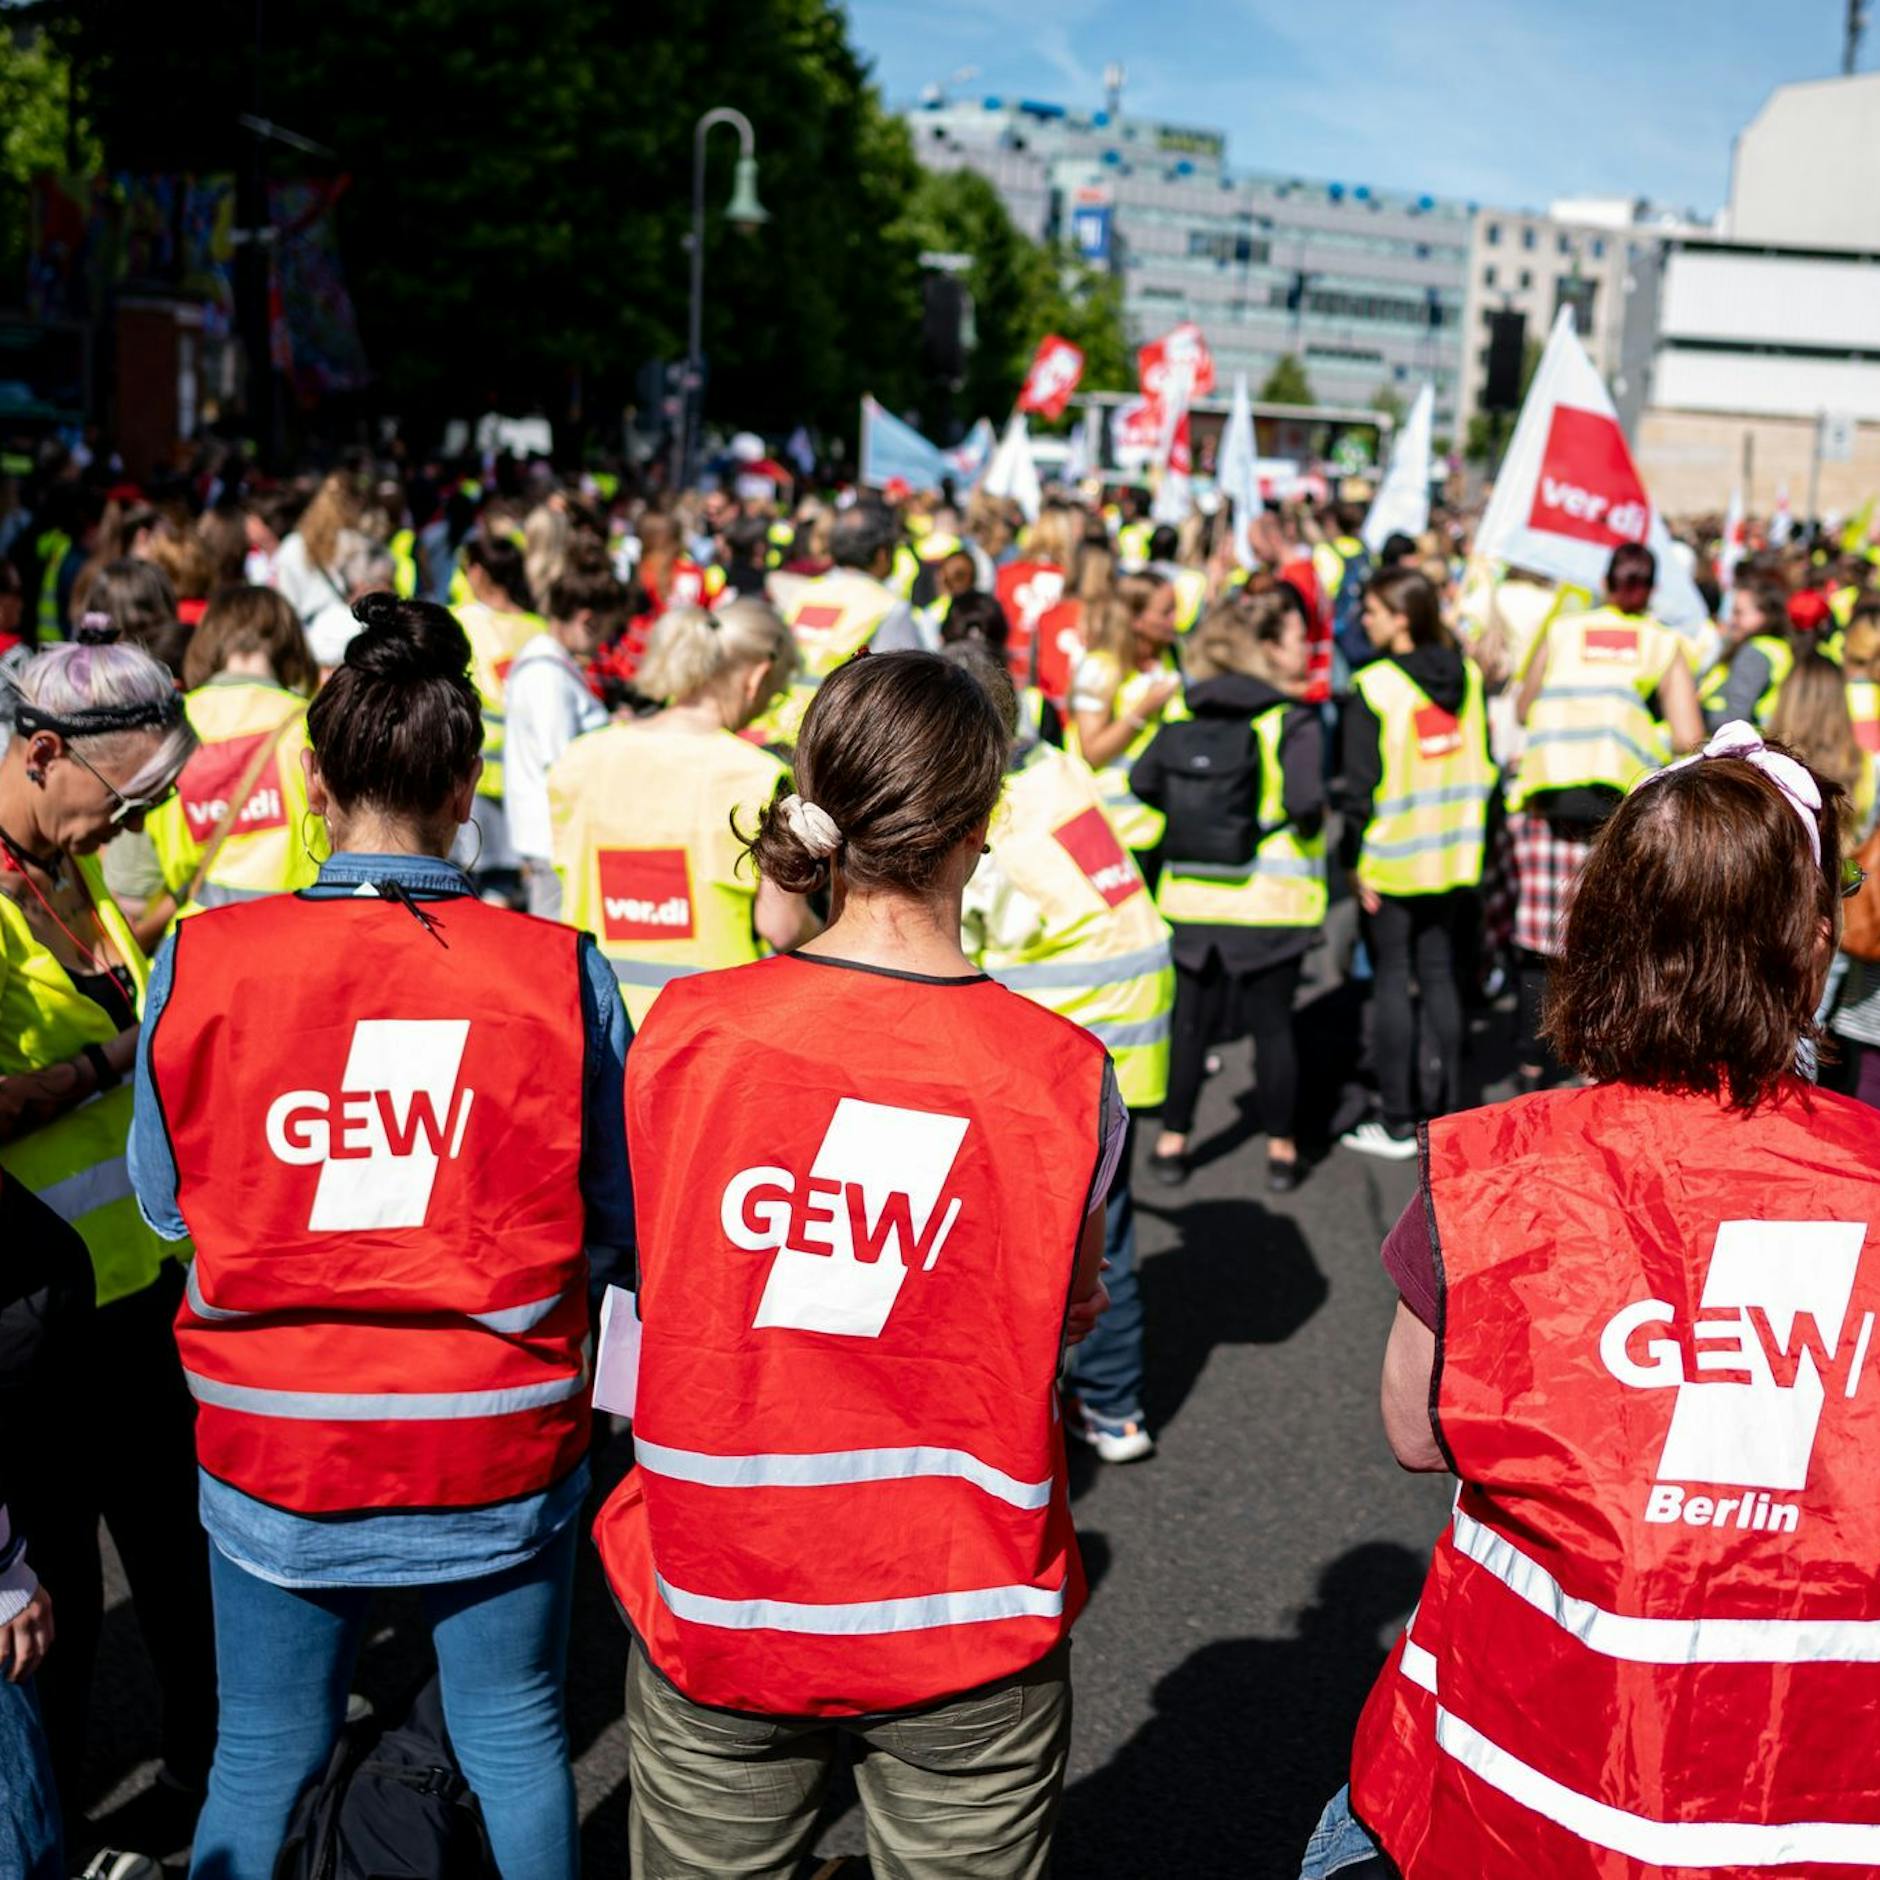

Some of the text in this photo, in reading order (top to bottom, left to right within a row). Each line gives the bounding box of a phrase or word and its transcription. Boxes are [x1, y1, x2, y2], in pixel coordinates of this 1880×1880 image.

[186, 787, 280, 825] ve.di
[604, 896, 690, 926] ver.di
[1644, 1484, 1800, 1533] Berlin
